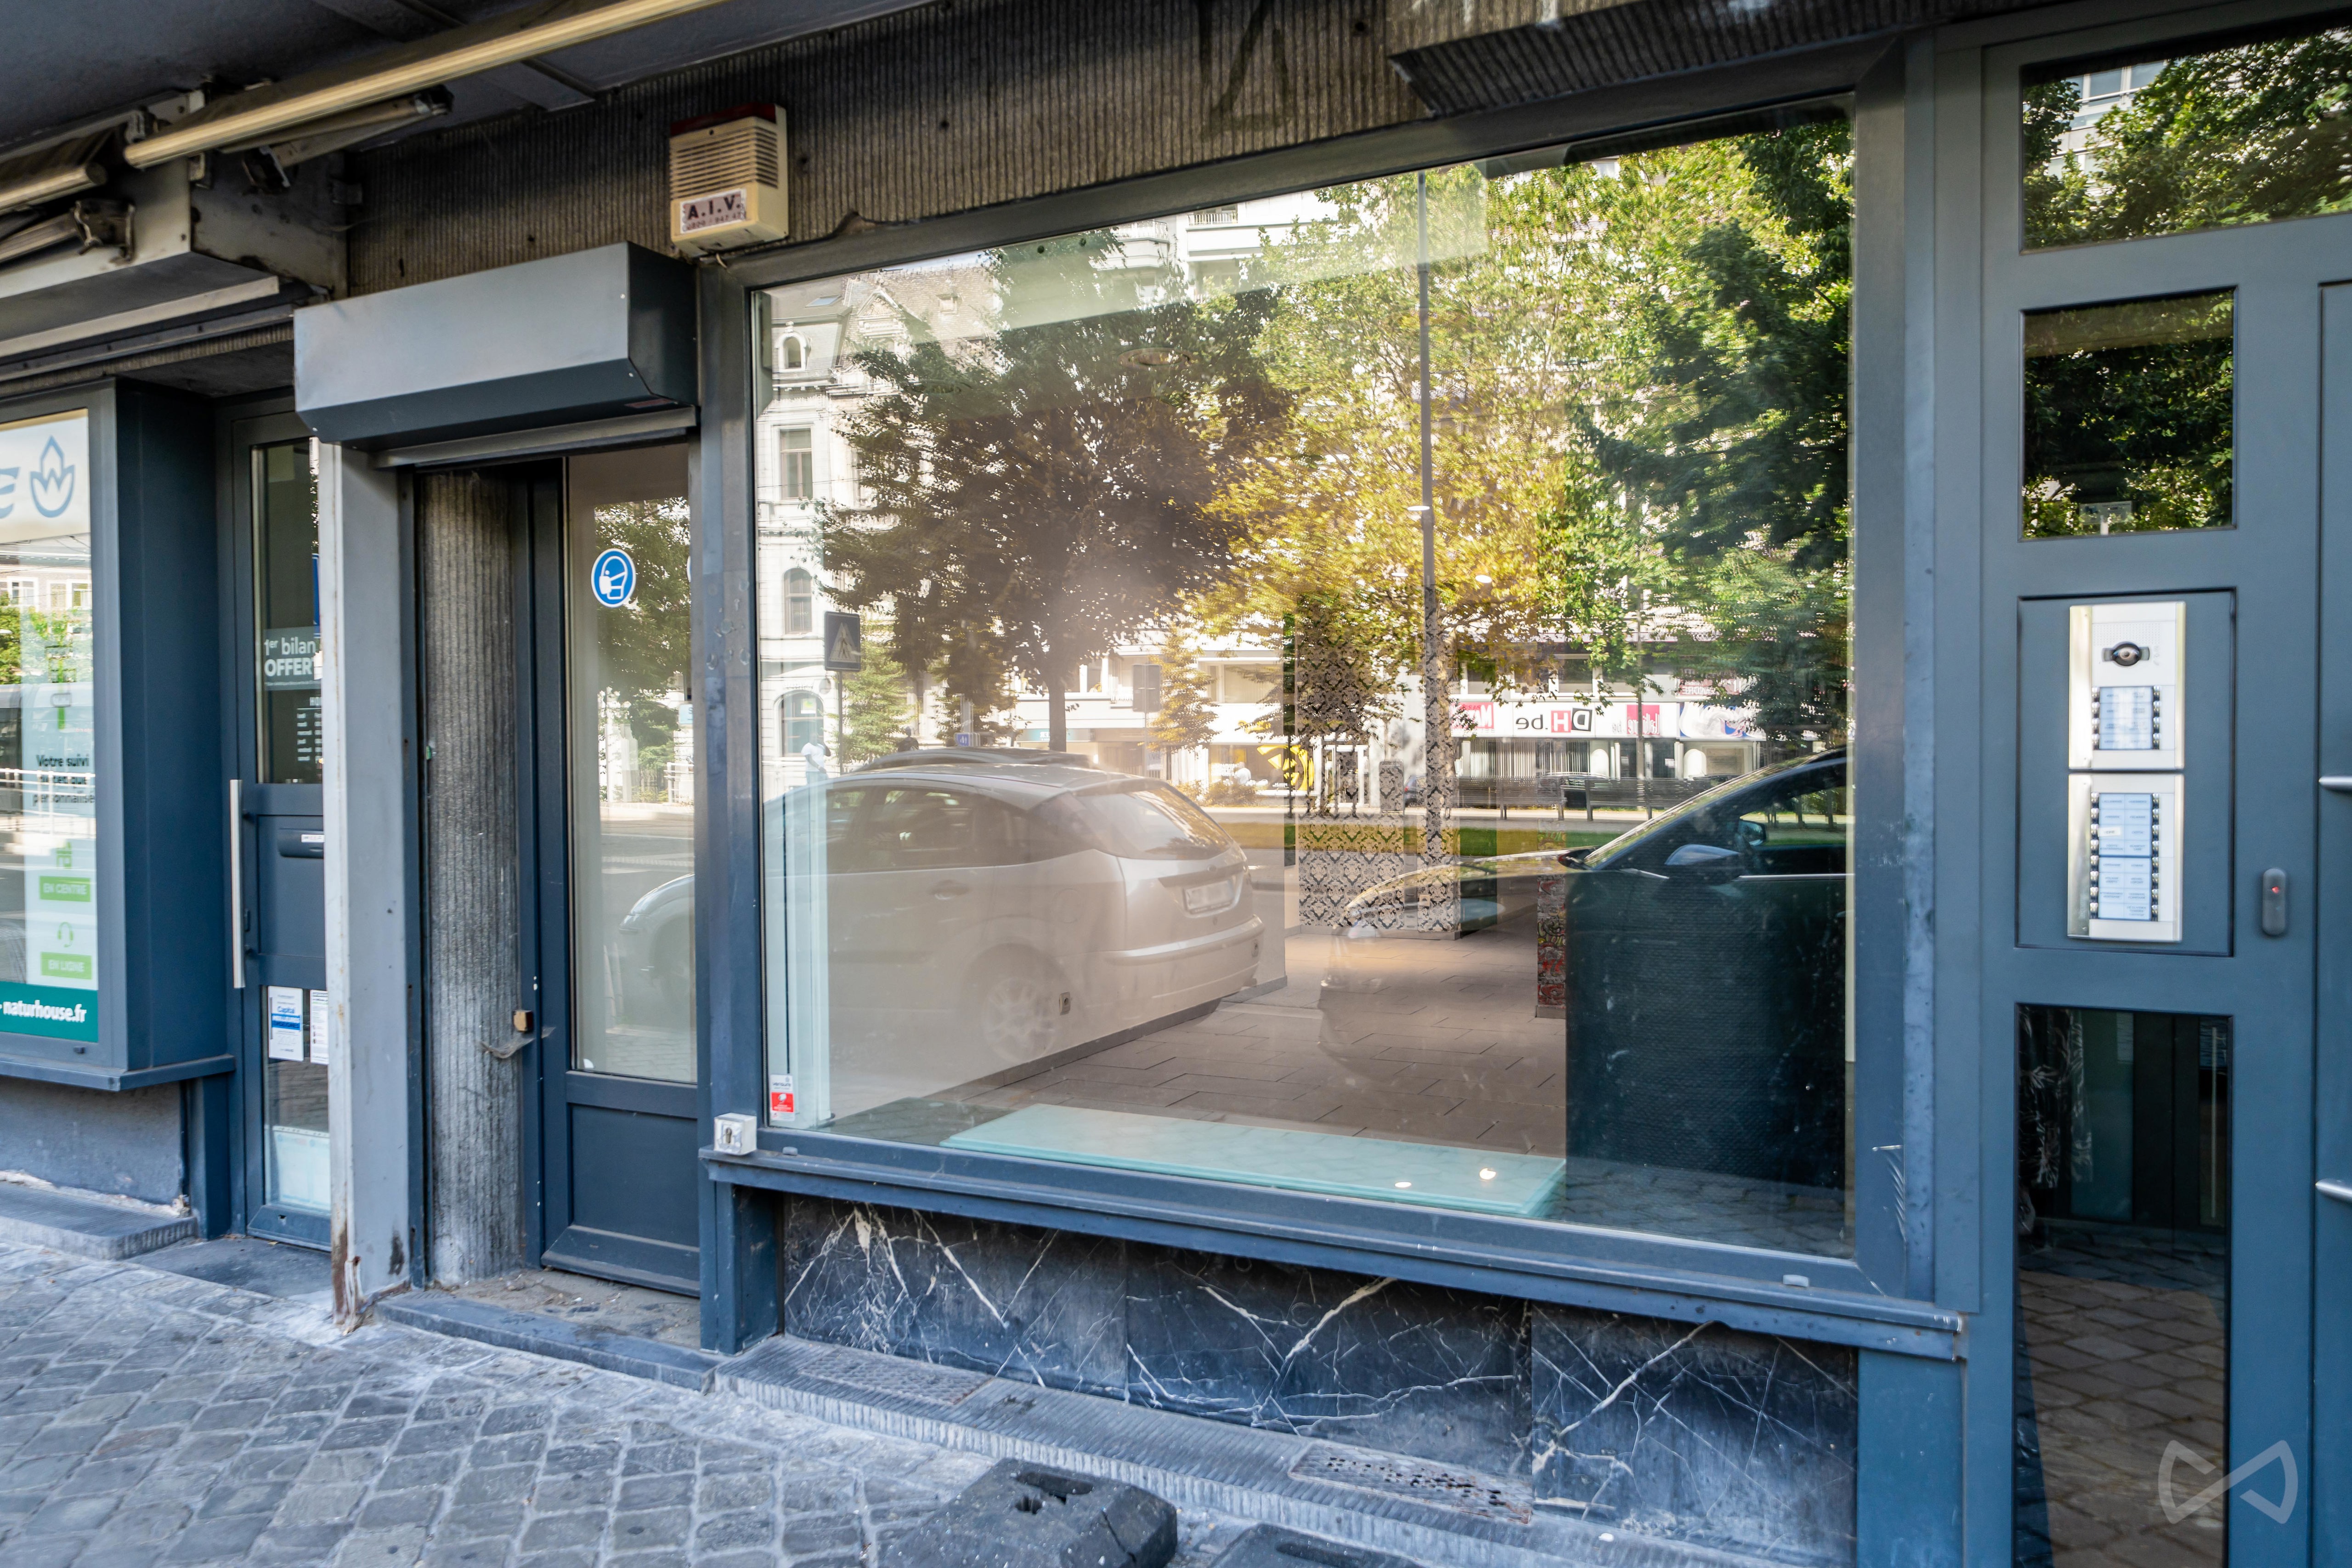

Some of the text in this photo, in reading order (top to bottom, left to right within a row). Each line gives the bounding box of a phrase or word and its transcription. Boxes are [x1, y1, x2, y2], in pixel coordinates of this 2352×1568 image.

[688, 194, 741, 220] A.I.V.
[281, 636, 316, 655] bilan
[264, 657, 314, 676] OFFER
[36, 753, 90, 766] Votre suivi
[3, 999, 87, 1023] naturhouse.fr
